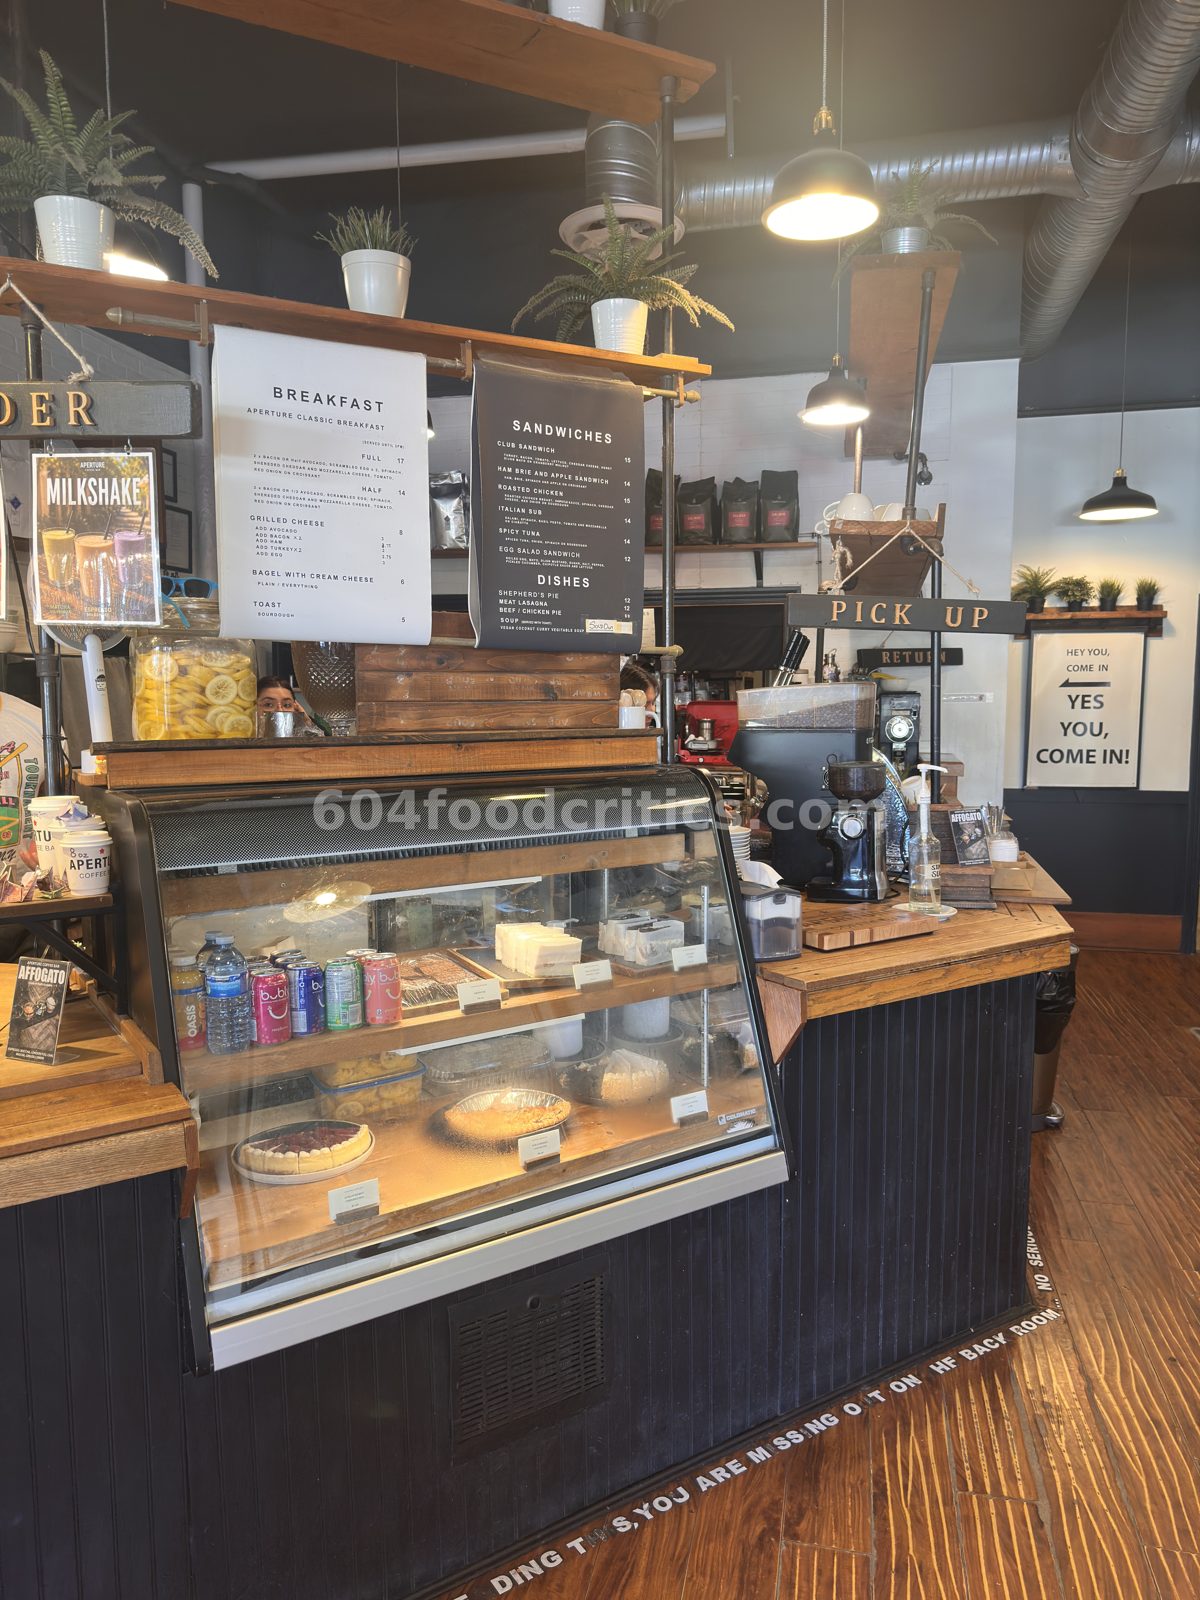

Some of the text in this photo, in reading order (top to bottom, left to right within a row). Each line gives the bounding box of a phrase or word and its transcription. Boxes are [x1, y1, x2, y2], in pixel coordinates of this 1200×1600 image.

[273, 386, 384, 413] BREAKFAST
[247, 407, 385, 431] APERTURE CLASSIC BREAKFAST
[512, 420, 612, 444] SANDWICHES
[497, 440, 555, 454] CLUB SANDWICH
[362, 454, 382, 462] FULL
[516, 468, 532, 476] BRIE
[550, 472, 572, 480] APPLE
[575, 476, 609, 484] SANDWICH
[47, 477, 141, 506] MILKSHAKE
[362, 486, 382, 494] HALF
[498, 484, 564, 496] ROASTED CHICKEN
[498, 506, 526, 514] ITALIAN
[250, 514, 288, 524] GRILLED
[292, 518, 325, 528] CHEESE
[544, 550, 580, 558] SANDWICH
[282, 582, 318, 590] EVERYTHING
[342, 575, 374, 583] CHEESE
[538, 574, 590, 588] DISHES
[498, 590, 545, 598] SHEPHERD'S
[831, 600, 989, 628] PICK UP
[1066, 648, 1110, 658] HEY YOU,
[1066, 663, 1109, 672] COME IN
[1067, 693, 1105, 710] YES
[1060, 721, 1110, 740] YOU,
[1036, 748, 1131, 765] COME IN!
[952, 812, 982, 822] AFFOGATO
[70, 848, 76, 858] 8
[18, 965, 66, 985] AFFOGATO
[1034, 1274, 1053, 1291] NO
[633, 1486, 690, 1520] YOU
[696, 1458, 748, 1492] ARE
[890, 1374, 922, 1392] ON
[958, 1332, 1008, 1361] BACK
